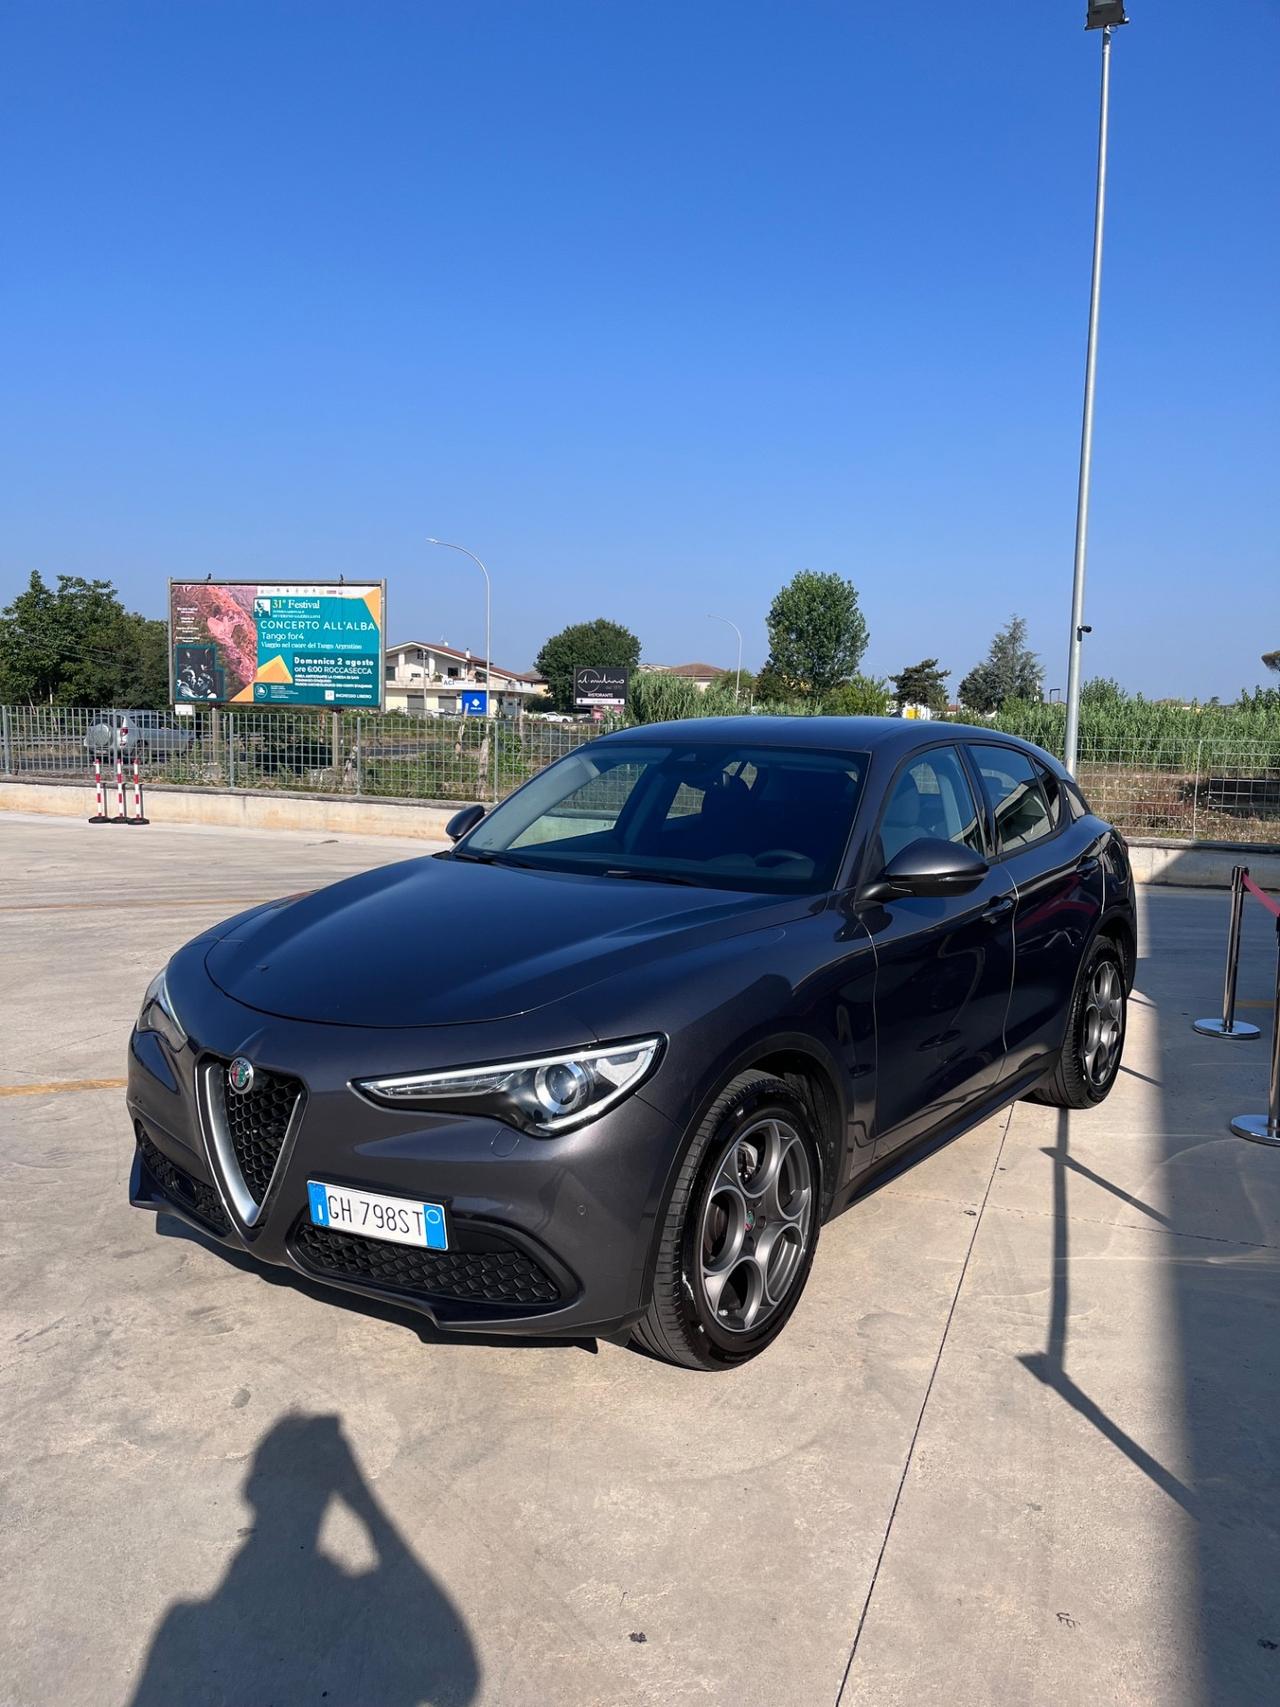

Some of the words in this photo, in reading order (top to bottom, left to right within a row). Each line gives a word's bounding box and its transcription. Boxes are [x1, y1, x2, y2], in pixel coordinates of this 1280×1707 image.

[288, 600, 320, 609] Festival
[260, 620, 320, 630] CONCERTO
[323, 621, 376, 631] ALL'ALBA
[262, 632, 287, 641] Tango
[261, 641, 281, 649] Viaggio
[317, 642, 334, 650] Tango
[294, 656, 335, 665] Domenica
[337, 657, 343, 665] 2
[345, 659, 374, 667] agosto
[324, 666, 373, 675] ROCCASECCA
